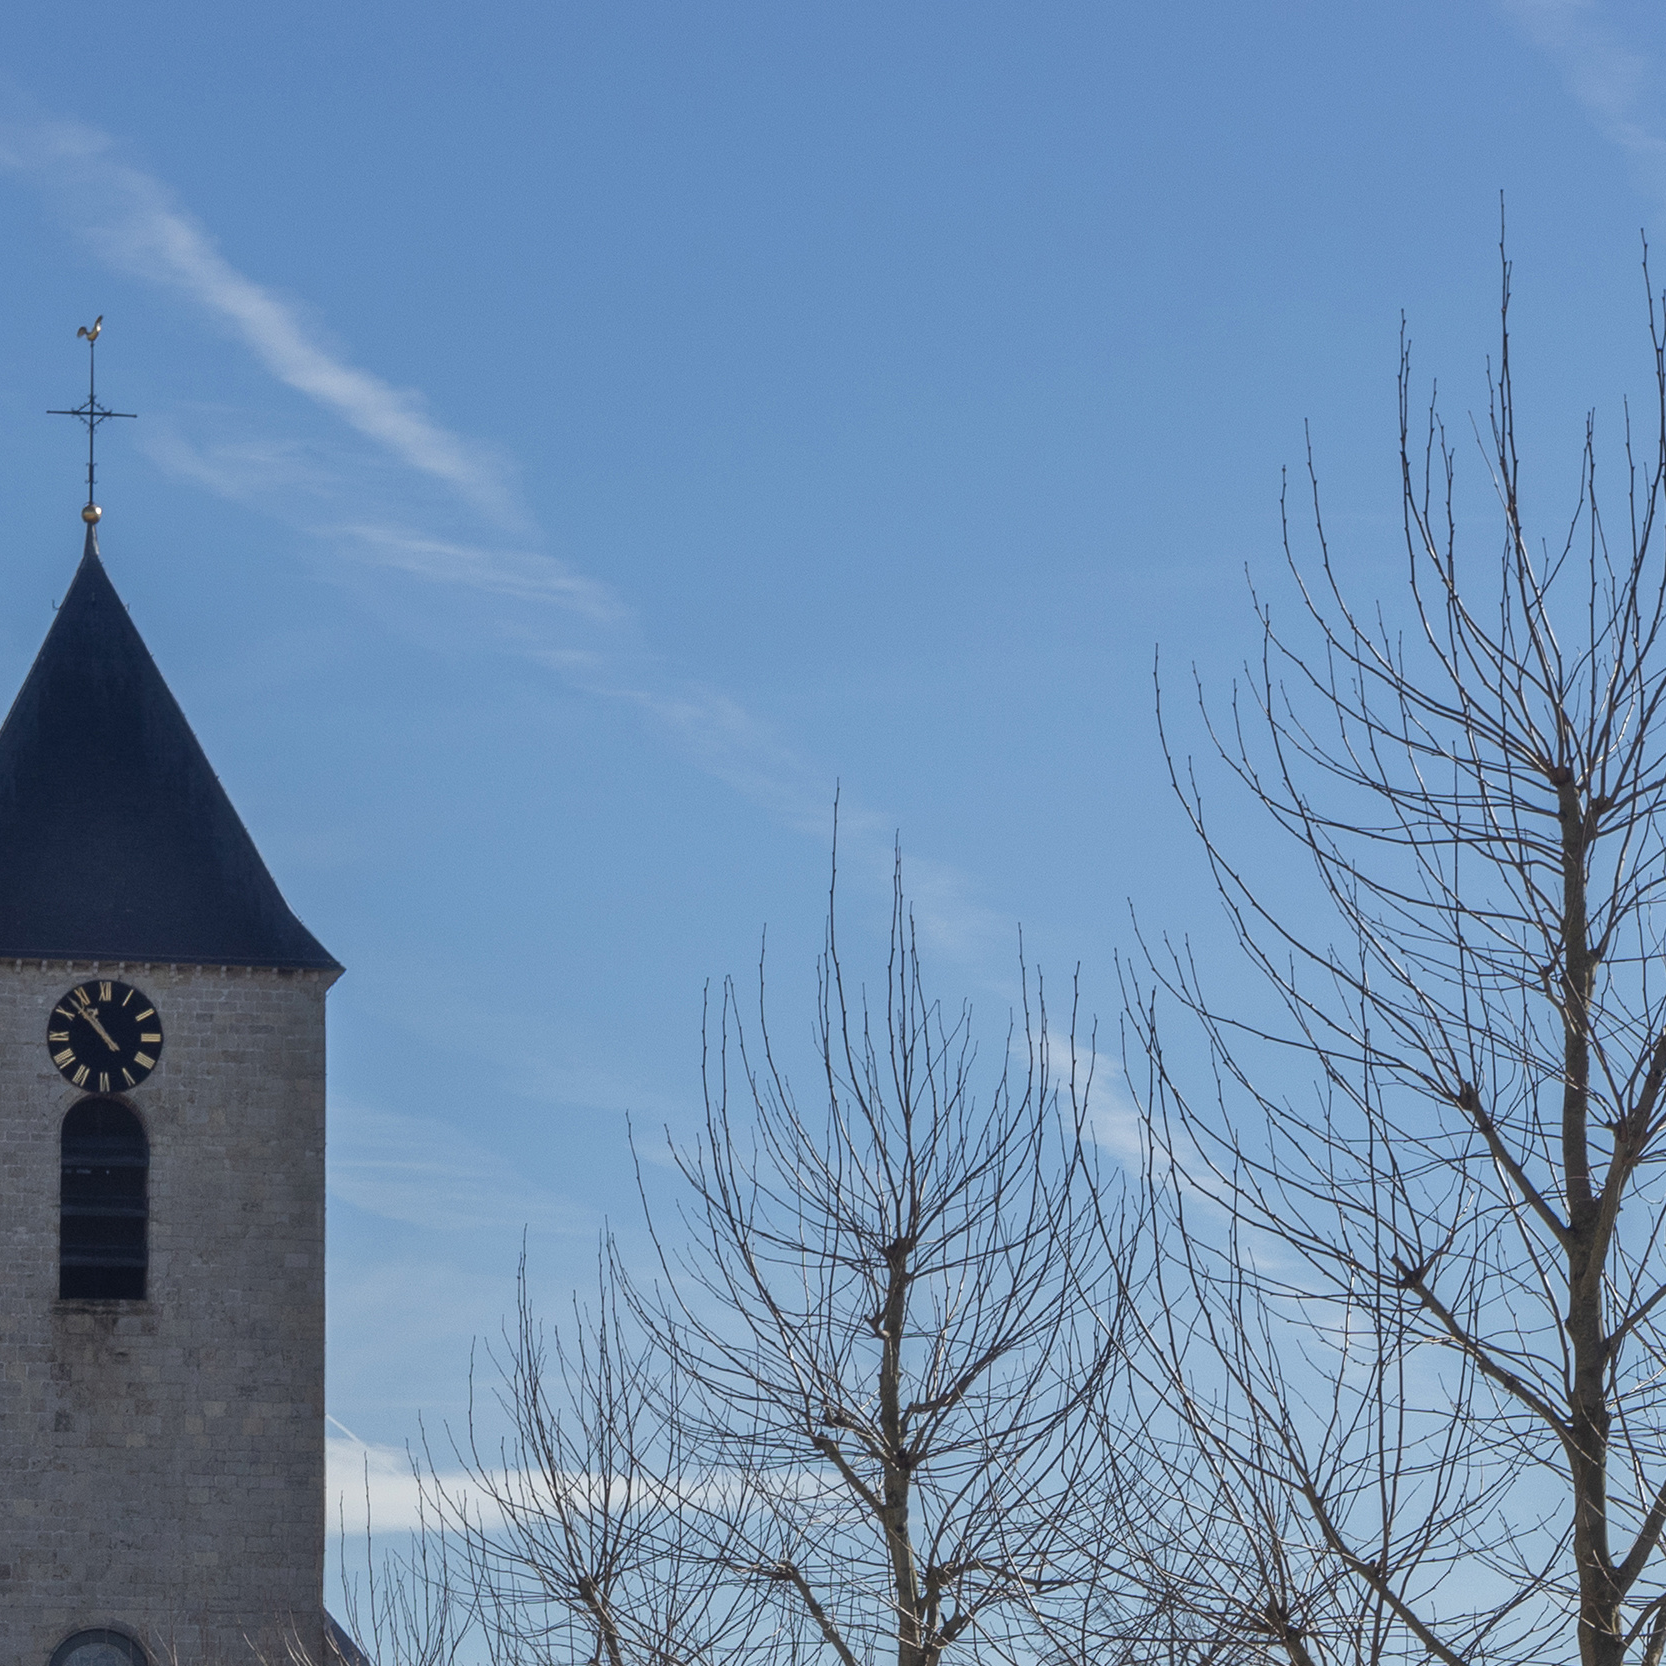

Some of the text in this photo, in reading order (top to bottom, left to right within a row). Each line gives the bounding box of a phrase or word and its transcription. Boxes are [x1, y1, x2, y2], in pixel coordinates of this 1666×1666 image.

[74, 986, 91, 1006] XI
[99, 981, 112, 1002] XII
[122, 989, 134, 1007] I
[55, 1005, 75, 1021] X
[135, 1008, 155, 1022] II
[49, 1031, 70, 1042] IX
[140, 1033, 161, 1042] III
[53, 1048, 76, 1070] VIII
[72, 1064, 90, 1087] VII
[99, 1072, 110, 1092] VI
[122, 1067, 136, 1087] V
